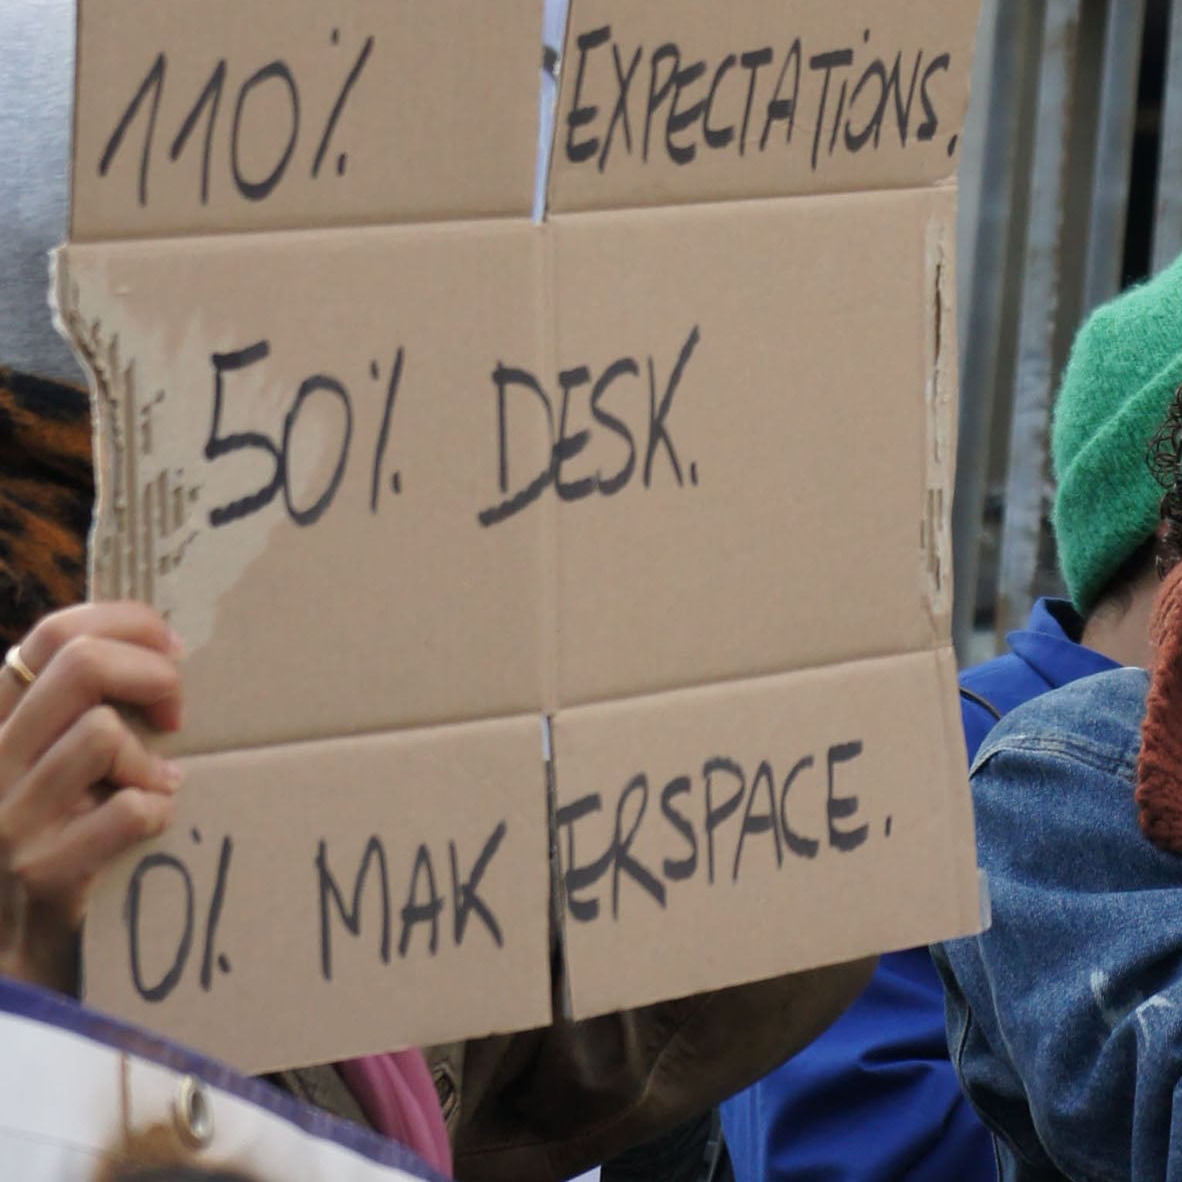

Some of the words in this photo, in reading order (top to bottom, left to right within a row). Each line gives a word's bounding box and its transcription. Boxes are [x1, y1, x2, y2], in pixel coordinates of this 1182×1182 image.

[97, 28, 375, 207] 110%
[205, 340, 404, 526] 50%
[479, 325, 700, 527] DESK.
[125, 828, 234, 1002] 0%
